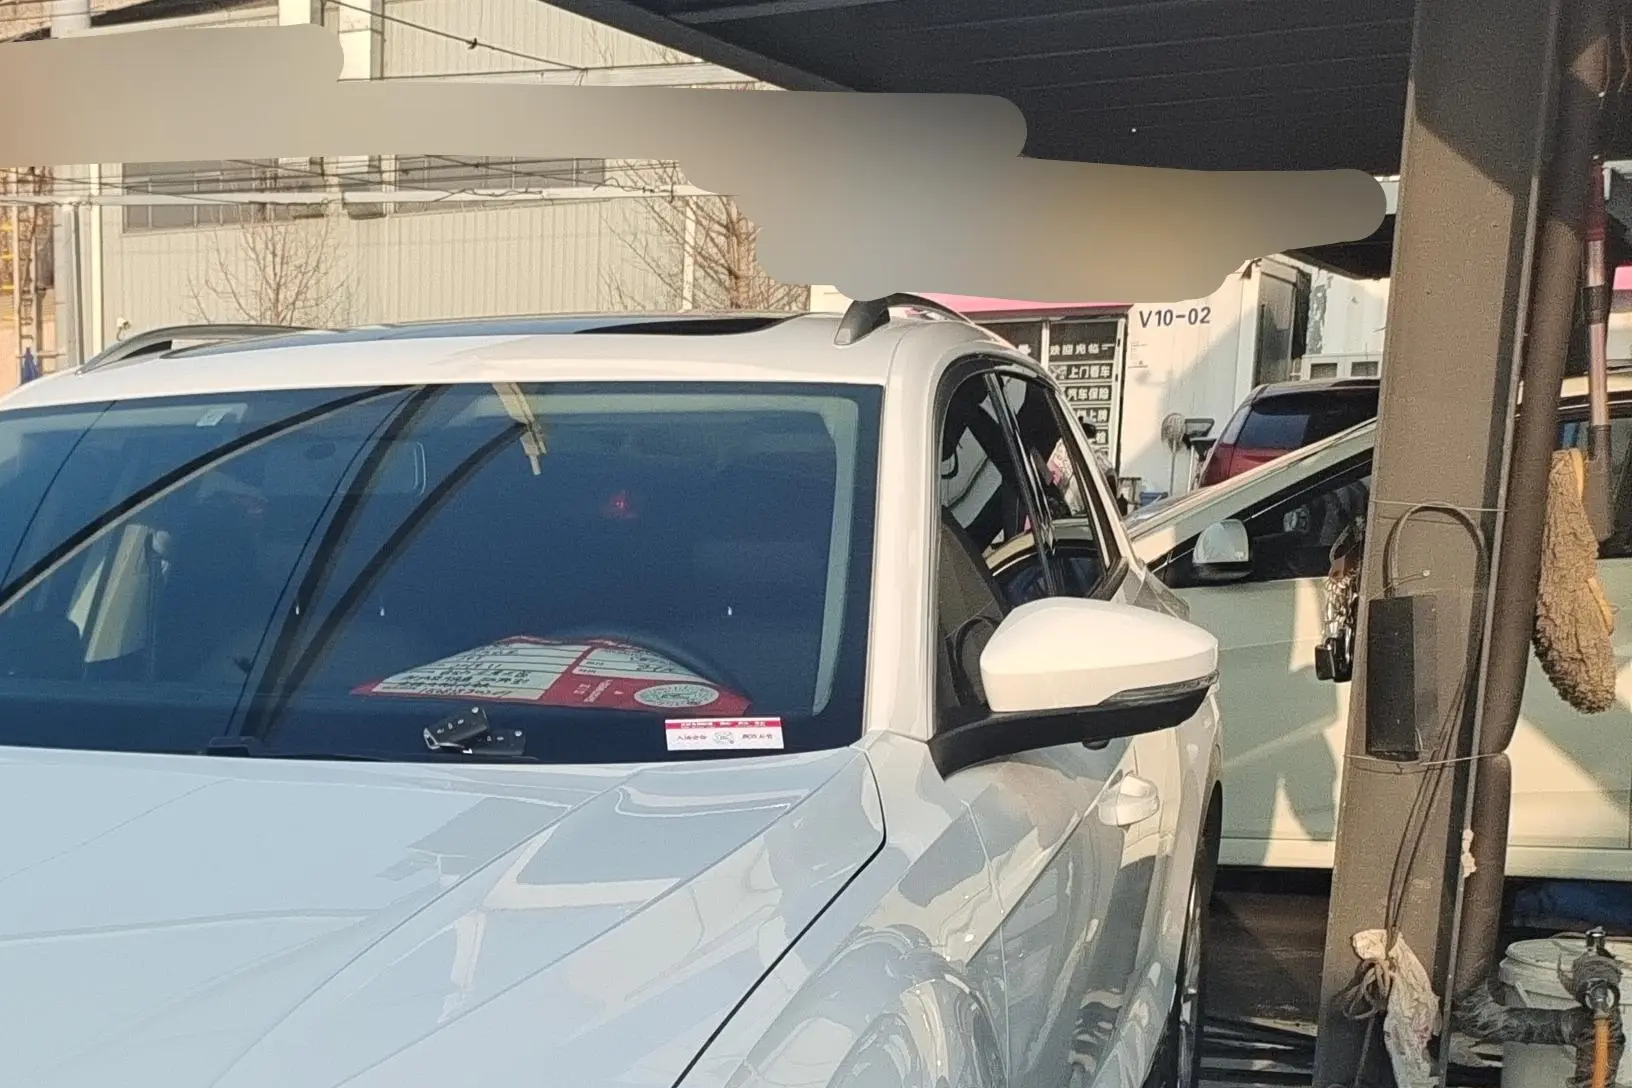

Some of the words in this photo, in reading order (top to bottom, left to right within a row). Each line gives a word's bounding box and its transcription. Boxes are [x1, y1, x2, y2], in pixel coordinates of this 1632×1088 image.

[1139, 306, 1212, 329] V10-02
[1049, 343, 1099, 356] 欢迎光临
[1068, 365, 1110, 379] 上门看车
[1067, 387, 1109, 401] 汽车保险
